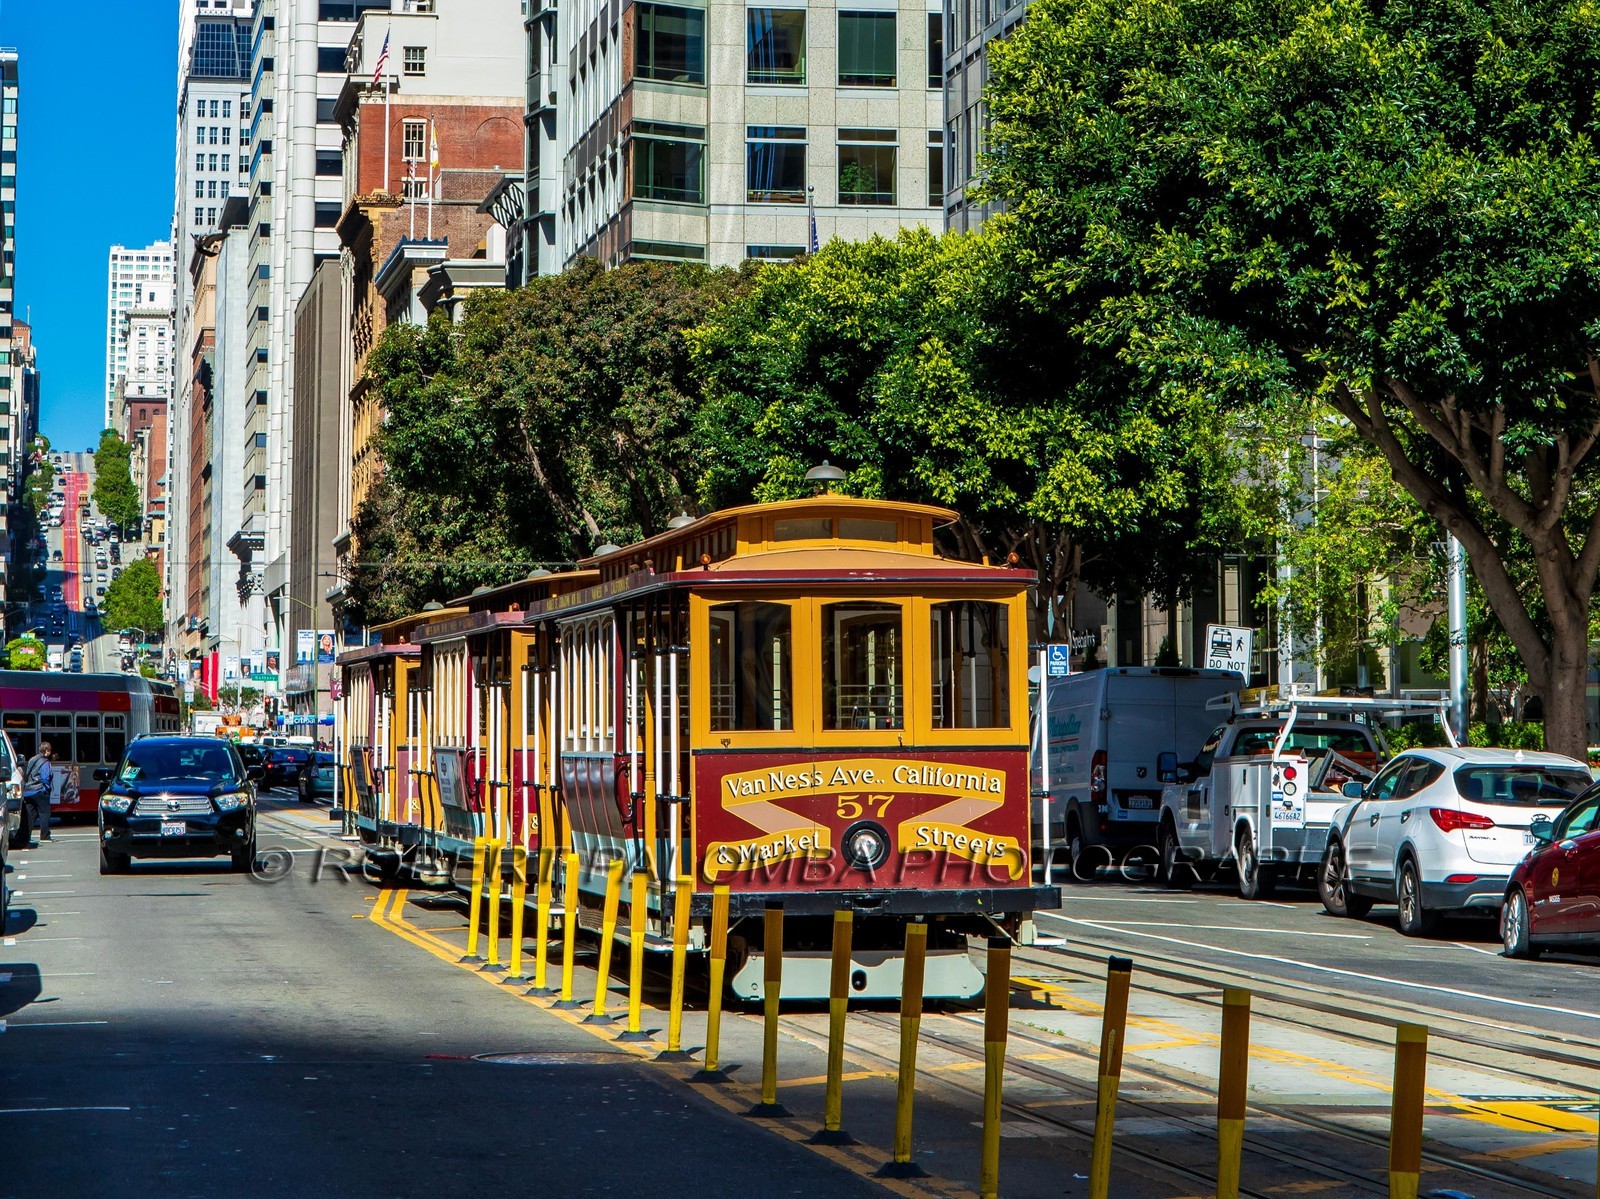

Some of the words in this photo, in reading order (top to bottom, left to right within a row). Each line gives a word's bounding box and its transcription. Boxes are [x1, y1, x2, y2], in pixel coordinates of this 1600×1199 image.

[1209, 659, 1222, 669] DO
[1227, 660, 1246, 671] NOT
[727, 779, 766, 798] Van
[768, 770, 824, 790] Ness
[893, 765, 1002, 794] California
[836, 794, 895, 819] 57
[717, 844, 737, 865] &
[739, 830, 821, 864] Market
[915, 825, 1009, 859] Streets
